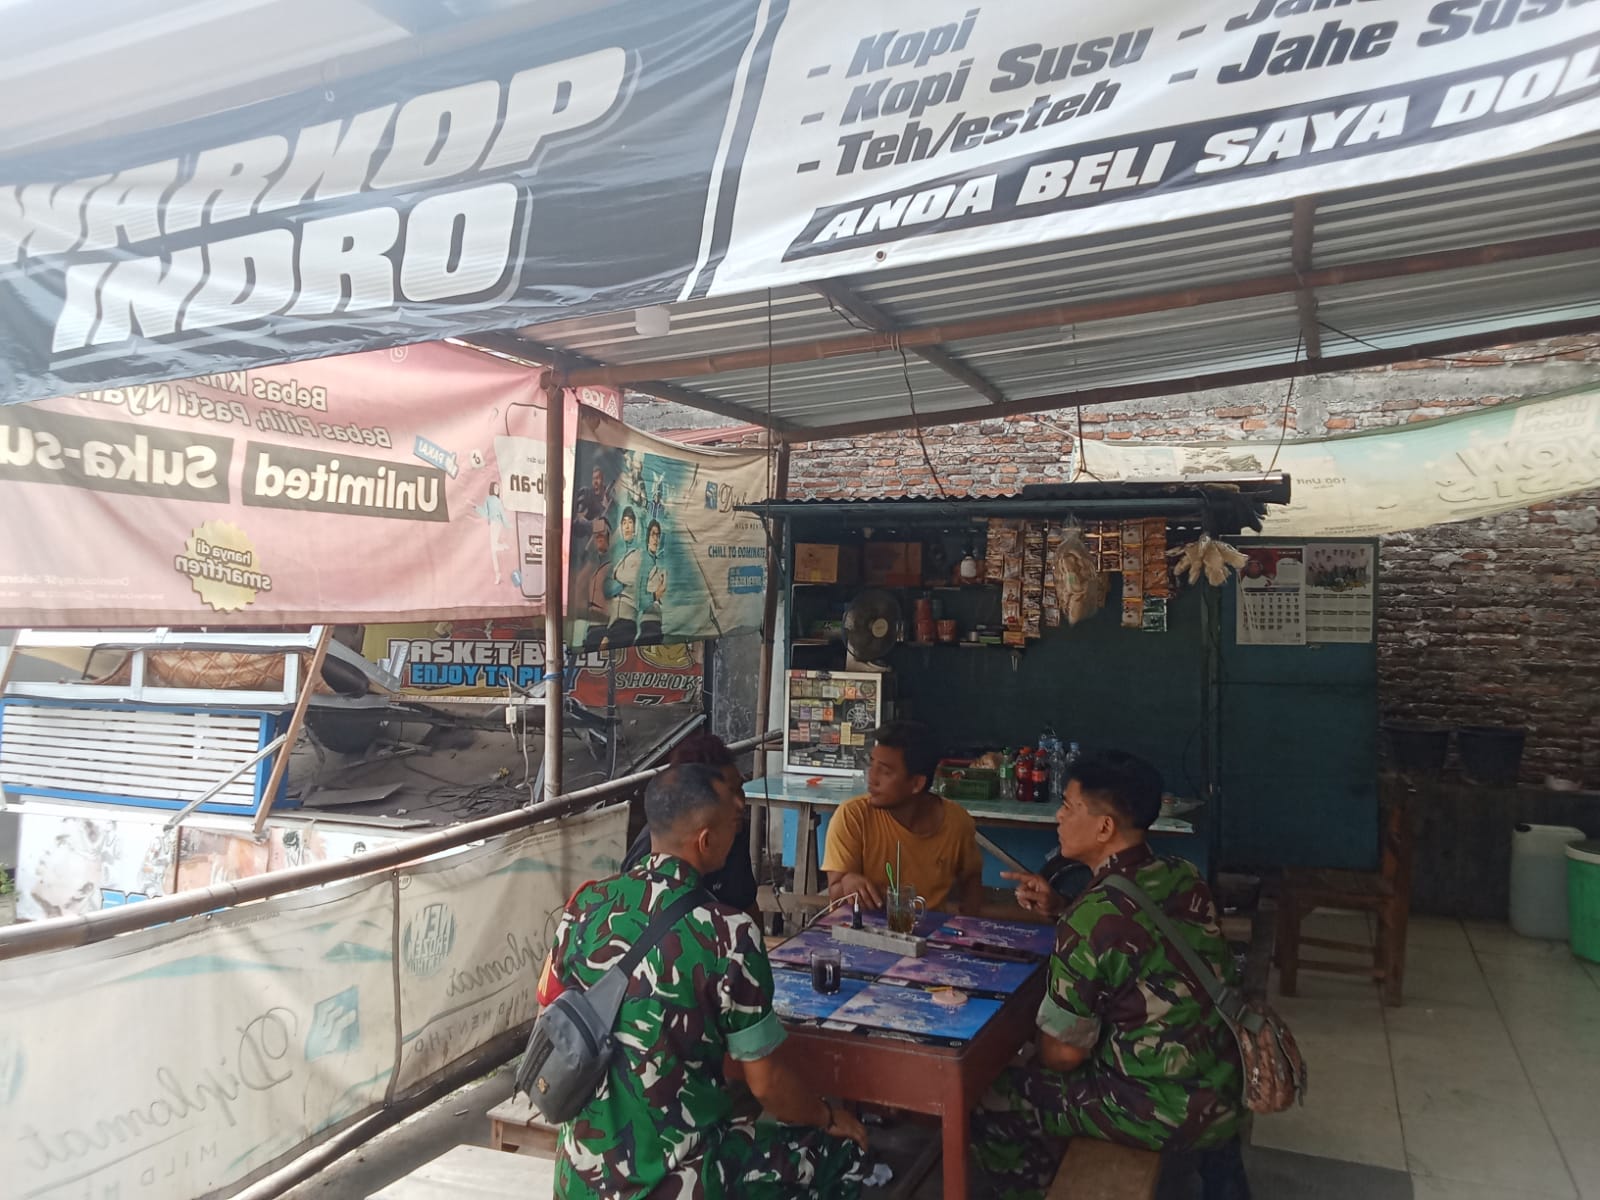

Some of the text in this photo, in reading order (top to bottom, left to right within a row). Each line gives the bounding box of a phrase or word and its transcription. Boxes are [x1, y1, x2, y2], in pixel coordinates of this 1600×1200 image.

[839, 27, 1153, 126] Kopi Susu
[845, 8, 981, 78] Kopi
[1217, 20, 1398, 84] Jahe
[1416, 0, 1600, 48] Sus
[0, 46, 626, 264] WARKOP
[812, 174, 998, 244] ANDA
[1016, 140, 1177, 206] BELI
[1195, 95, 1410, 174] SAYA
[836, 79, 1122, 176] Teh/esteh
[51, 182, 519, 353] INDRO
[412, 664, 479, 686] ENJOY
[484, 665, 513, 687] TO
